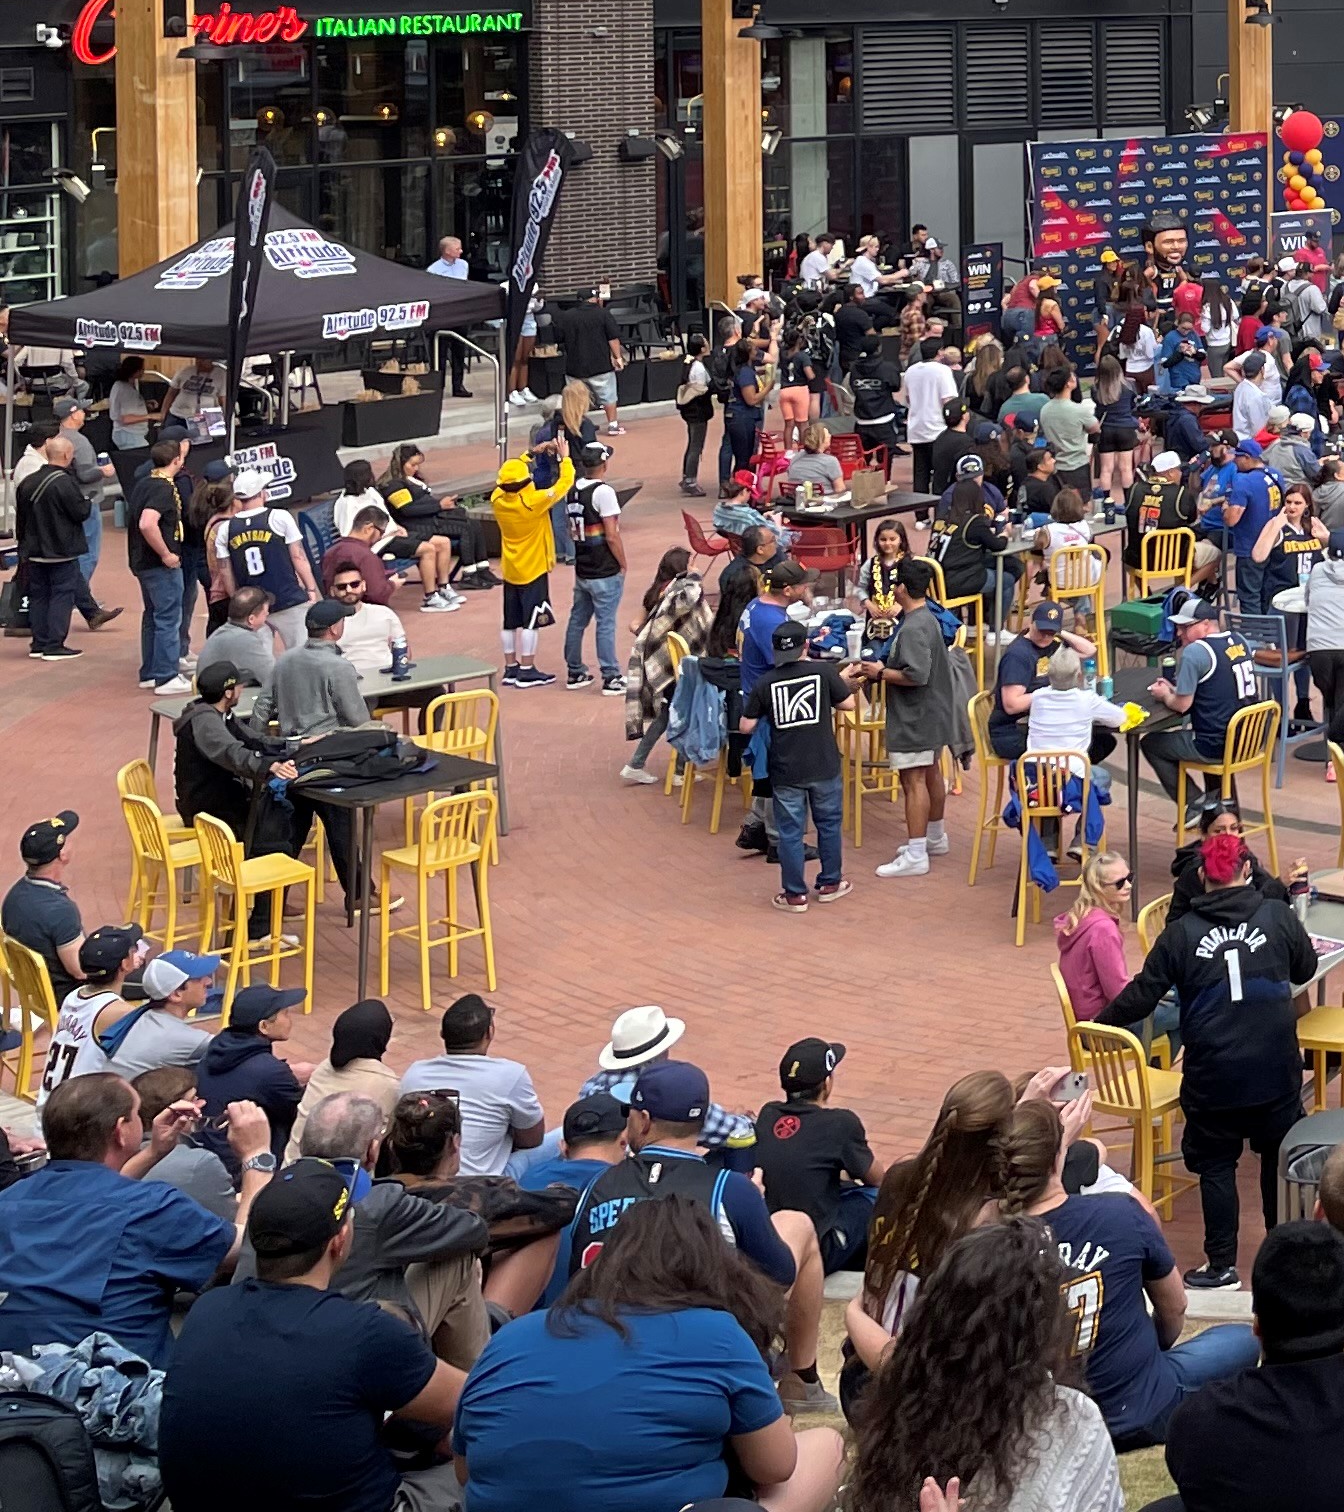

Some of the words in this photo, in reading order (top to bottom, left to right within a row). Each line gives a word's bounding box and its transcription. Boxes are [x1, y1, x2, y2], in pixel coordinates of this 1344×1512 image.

[316, 15, 395, 37] ITALIAN
[399, 12, 523, 35] RESTAURANT
[267, 233, 300, 246] 92.5
[301, 231, 320, 242] FM
[514, 221, 537, 291] Altitude
[529, 178, 548, 220] 92.5
[268, 244, 347, 266] Altitude
[968, 263, 991, 276] WIN
[78, 321, 116, 341] Altitude
[120, 327, 142, 340] 92.5
[144, 328, 160, 342] FM
[325, 310, 376, 335] Altitude
[379, 305, 407, 323] 92.5
[409, 303, 427, 319] FM
[234, 448, 258, 465] 92.5
[259, 445, 274, 460] FM
[1283, 538, 1322, 553] DENVER
[245, 547, 265, 575] 8
[1297, 553, 1313, 574] 15
[1231, 660, 1256, 700] 15
[1196, 921, 1247, 959] PORTER
[1224, 947, 1244, 1002] 1
[42, 1042, 79, 1088] 27
